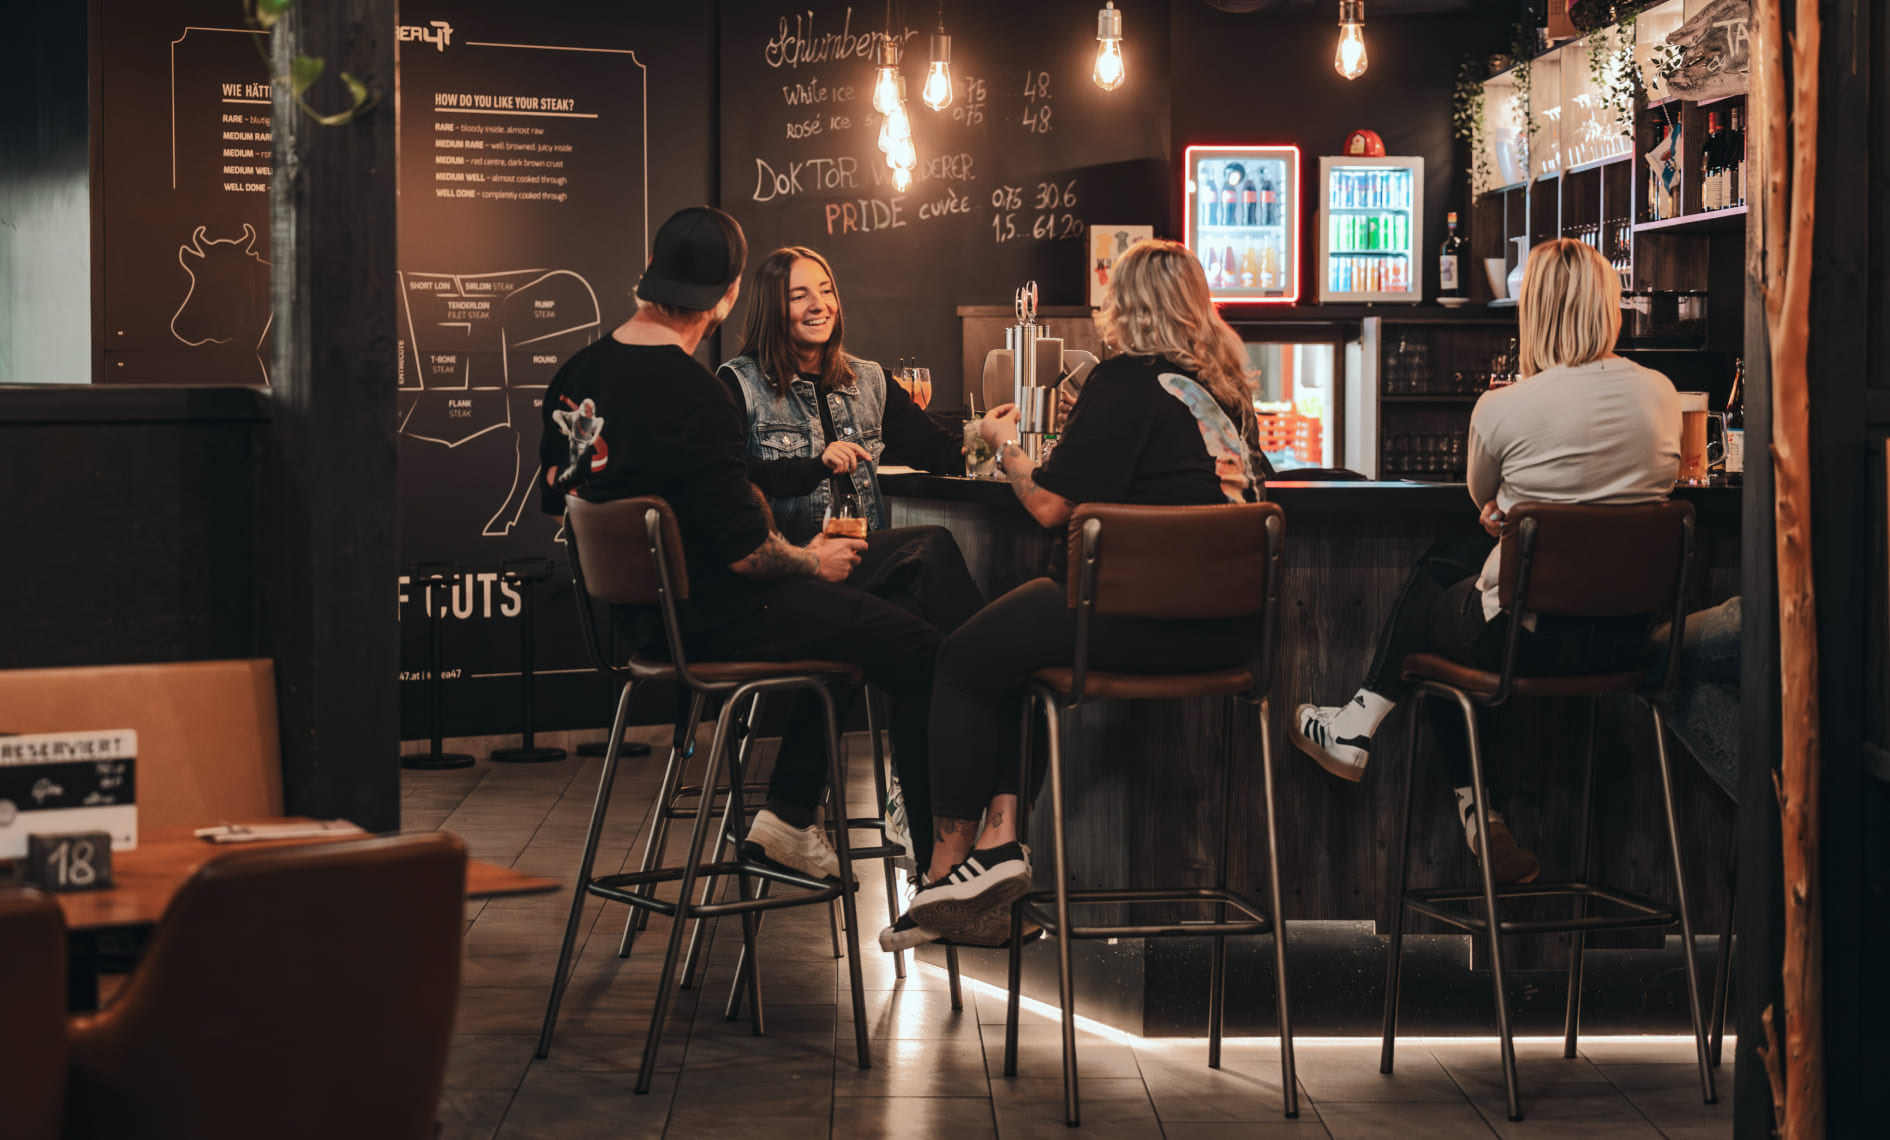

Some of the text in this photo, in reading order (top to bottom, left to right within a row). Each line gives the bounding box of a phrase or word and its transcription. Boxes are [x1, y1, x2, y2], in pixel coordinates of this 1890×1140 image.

[765, 6, 918, 68] Schlumberr
[222, 83, 242, 97] WIE
[435, 93, 574, 111] HOW DO YOU LIKE YOUR STEAK?
[223, 114, 244, 124] RARE
[435, 122, 454, 131] RARE
[461, 124, 484, 134] bloody
[507, 126, 530, 134] almost
[223, 131, 254, 140] MEDIUM
[435, 139, 464, 148] MEDIUM
[465, 140, 484, 149] RARE
[538, 143, 554, 152] juicy
[554, 144, 573, 152] inside
[223, 149, 254, 158] MEDIUM
[435, 156, 464, 165] MEDIUM
[470, 157, 483, 165] red
[507, 158, 522, 167] dark
[524, 158, 545, 167] brown
[546, 160, 563, 168] crust
[224, 166, 254, 175] MEDIUM
[435, 172, 568, 186] MEDIUM WELL almost cooked through
[224, 183, 266, 192] WELL DONE
[436, 189, 568, 202] WELL DONE completely cooked through
[825, 196, 907, 235] PRIDE
[409, 281, 451, 290] SHORT LOIN
[465, 282, 491, 291] SIRLOIN
[447, 301, 490, 310] TENDERLOIN
[534, 300, 555, 309] RUMP
[447, 311, 490, 319] FILET STEAK
[534, 310, 555, 318] STEAK
[430, 355, 457, 364] T-BONE
[533, 355, 557, 364] ROUND
[433, 365, 455, 374] STEAK
[448, 399, 472, 408] FLANK
[449, 409, 472, 418] STEAK
[48, 840, 96, 885] 18
